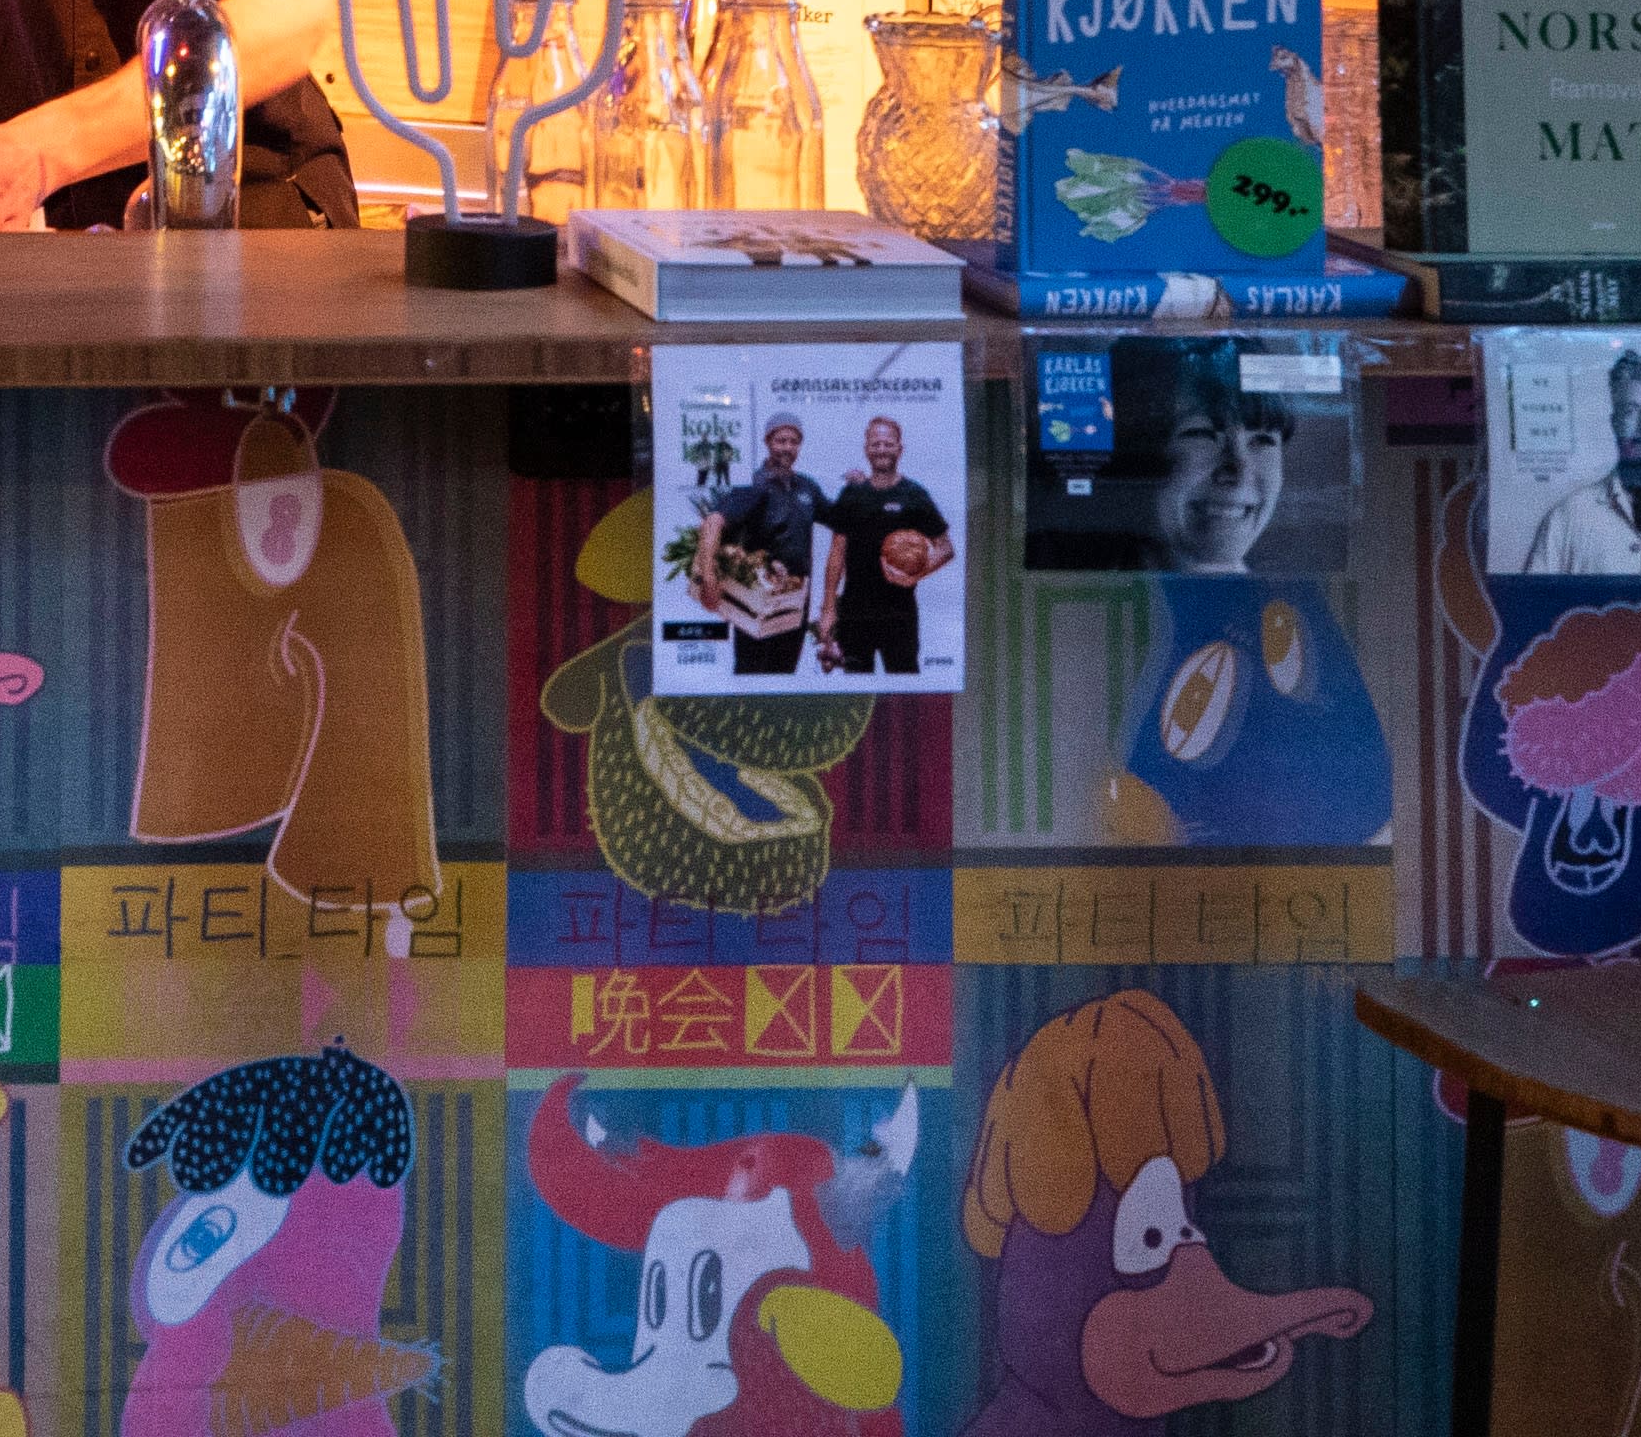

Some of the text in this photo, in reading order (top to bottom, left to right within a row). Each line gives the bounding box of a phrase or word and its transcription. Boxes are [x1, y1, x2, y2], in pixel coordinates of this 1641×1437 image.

[1044, 283, 1363, 315] KARLAS KJØKKEN
[106, 876, 268, 960] 파티
